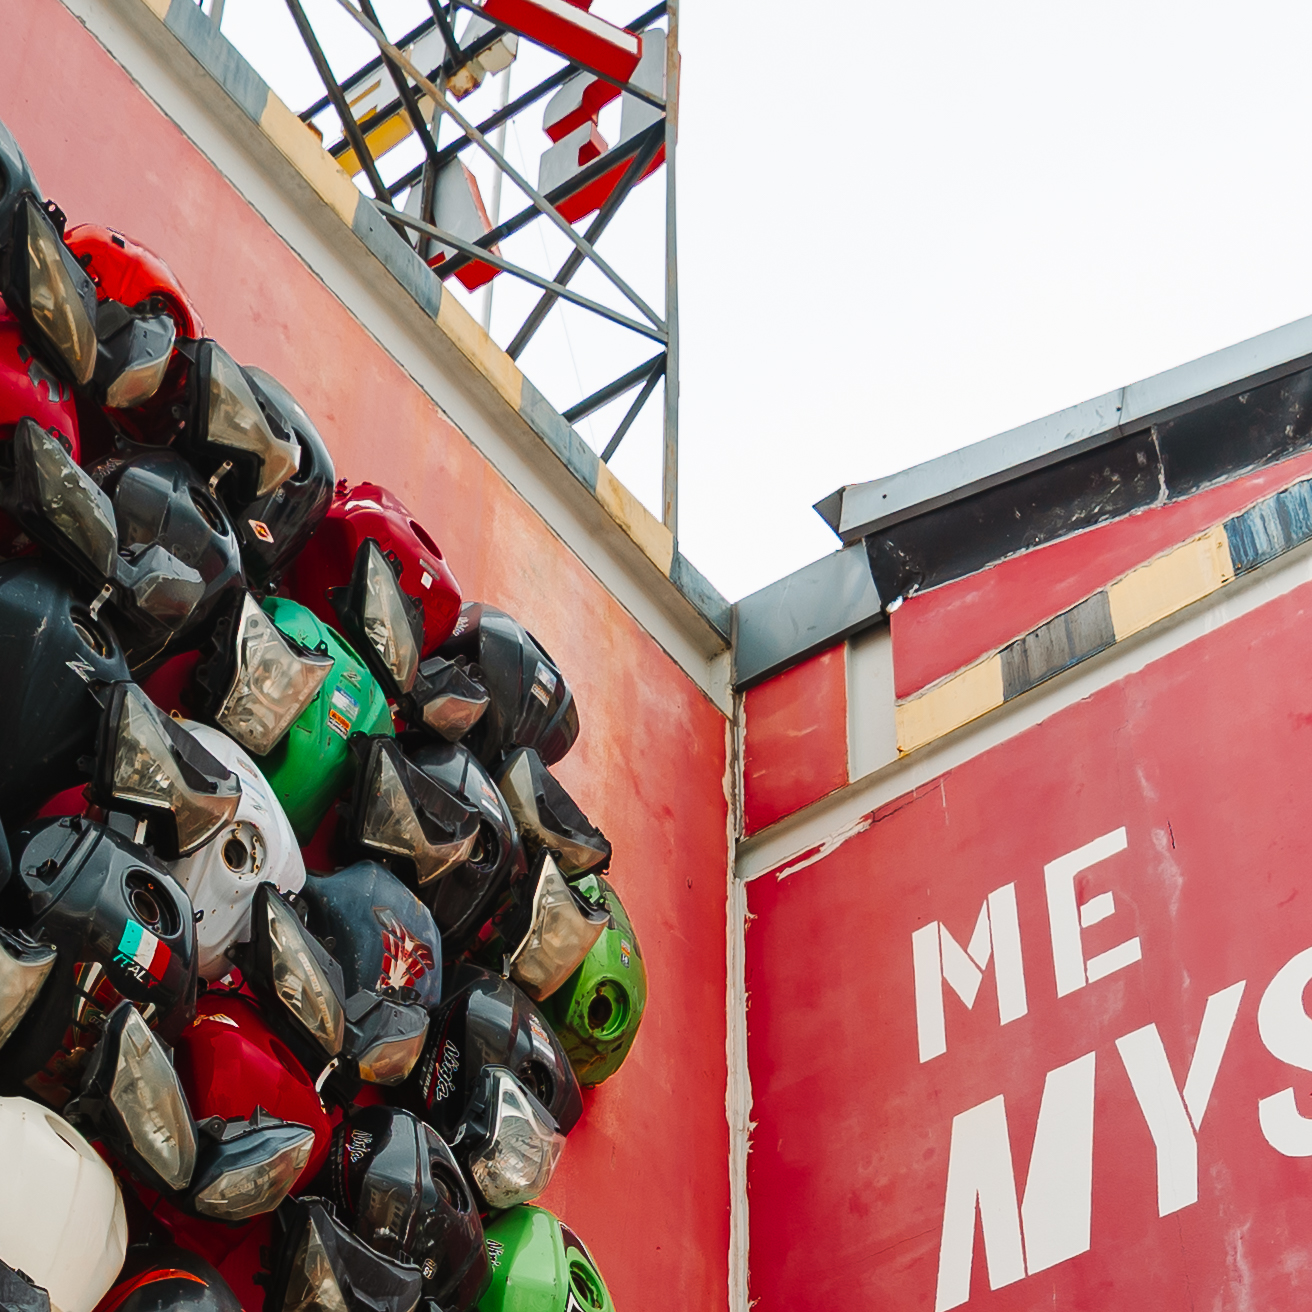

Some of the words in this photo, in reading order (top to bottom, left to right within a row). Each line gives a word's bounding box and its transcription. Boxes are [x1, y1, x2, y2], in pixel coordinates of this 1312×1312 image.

[912, 826, 1141, 1063] ME
[113, 954, 158, 988] ITALY
[436, 1040, 460, 1101] Ninja
[346, 1129, 372, 1163] Ninja
